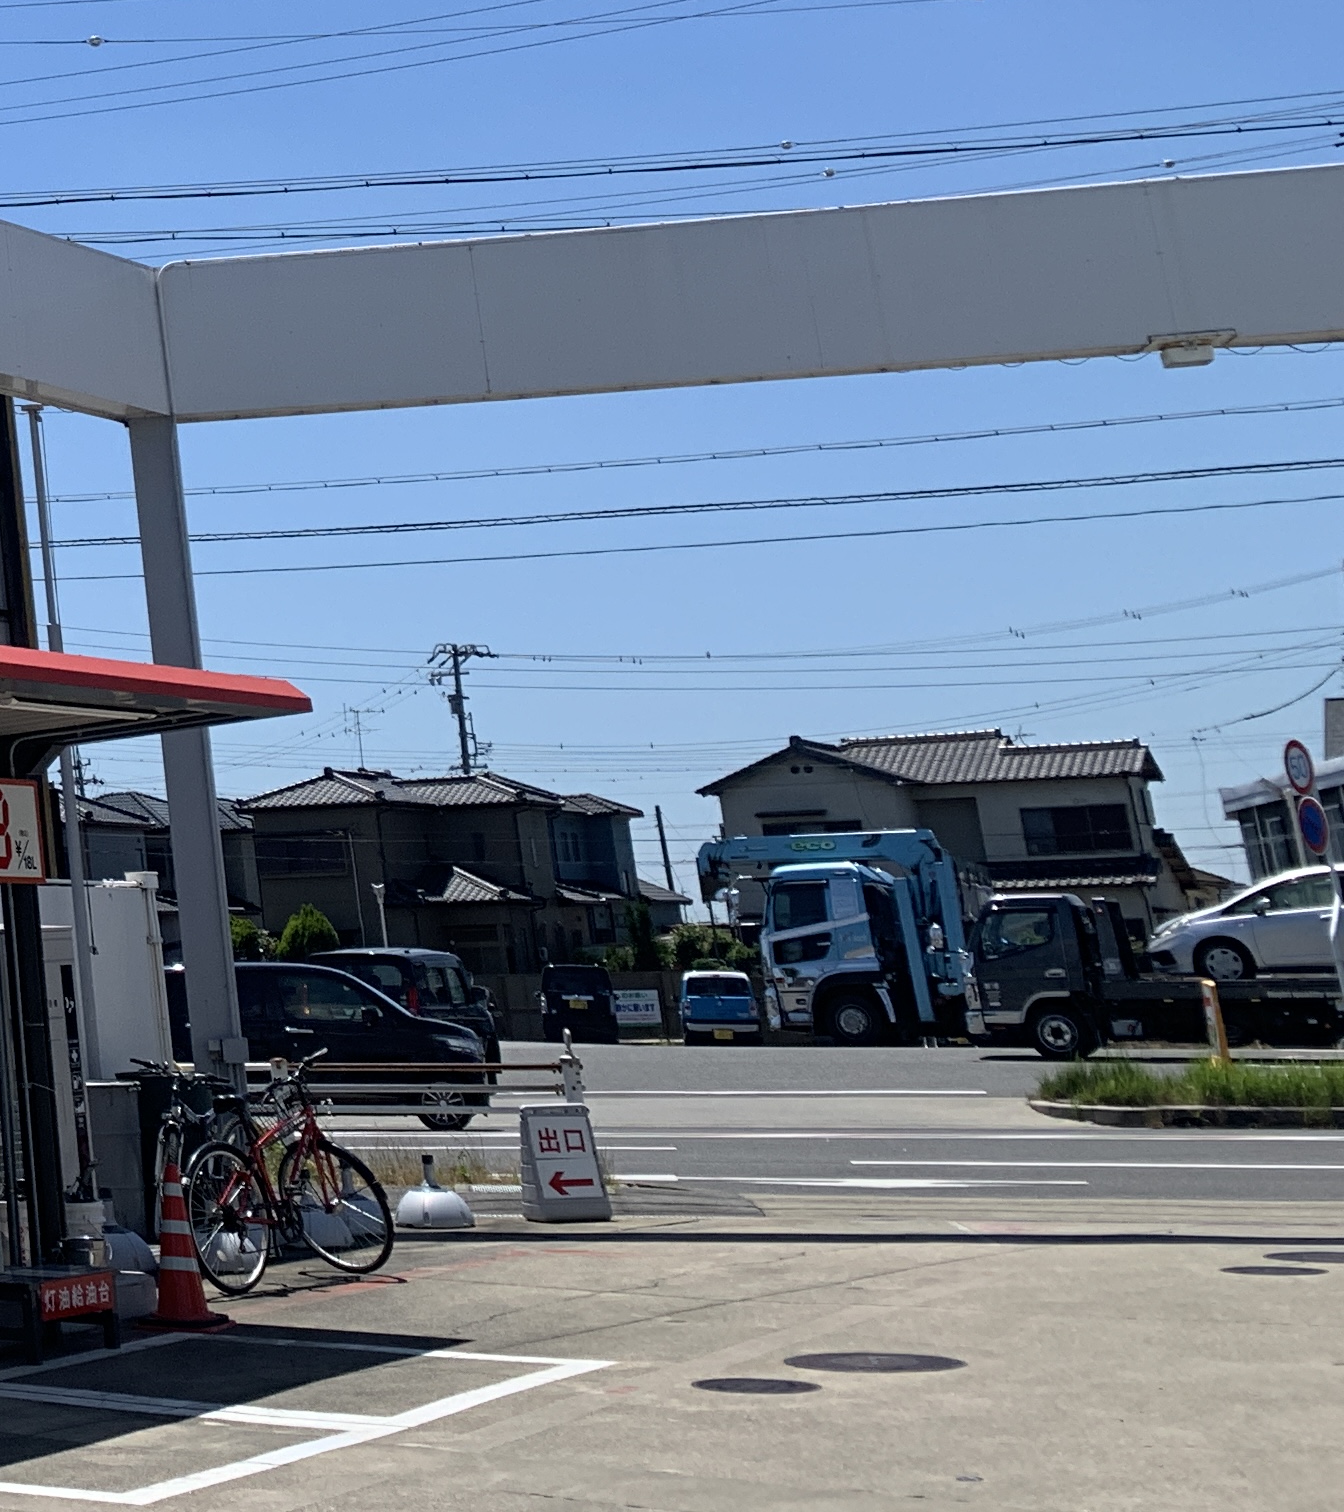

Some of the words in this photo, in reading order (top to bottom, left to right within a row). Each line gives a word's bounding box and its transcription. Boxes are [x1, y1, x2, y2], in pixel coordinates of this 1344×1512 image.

[1289, 753, 1308, 781] 50
[538, 1127, 586, 1153] 出口
[43, 1279, 110, 1313] 灯油給油台
